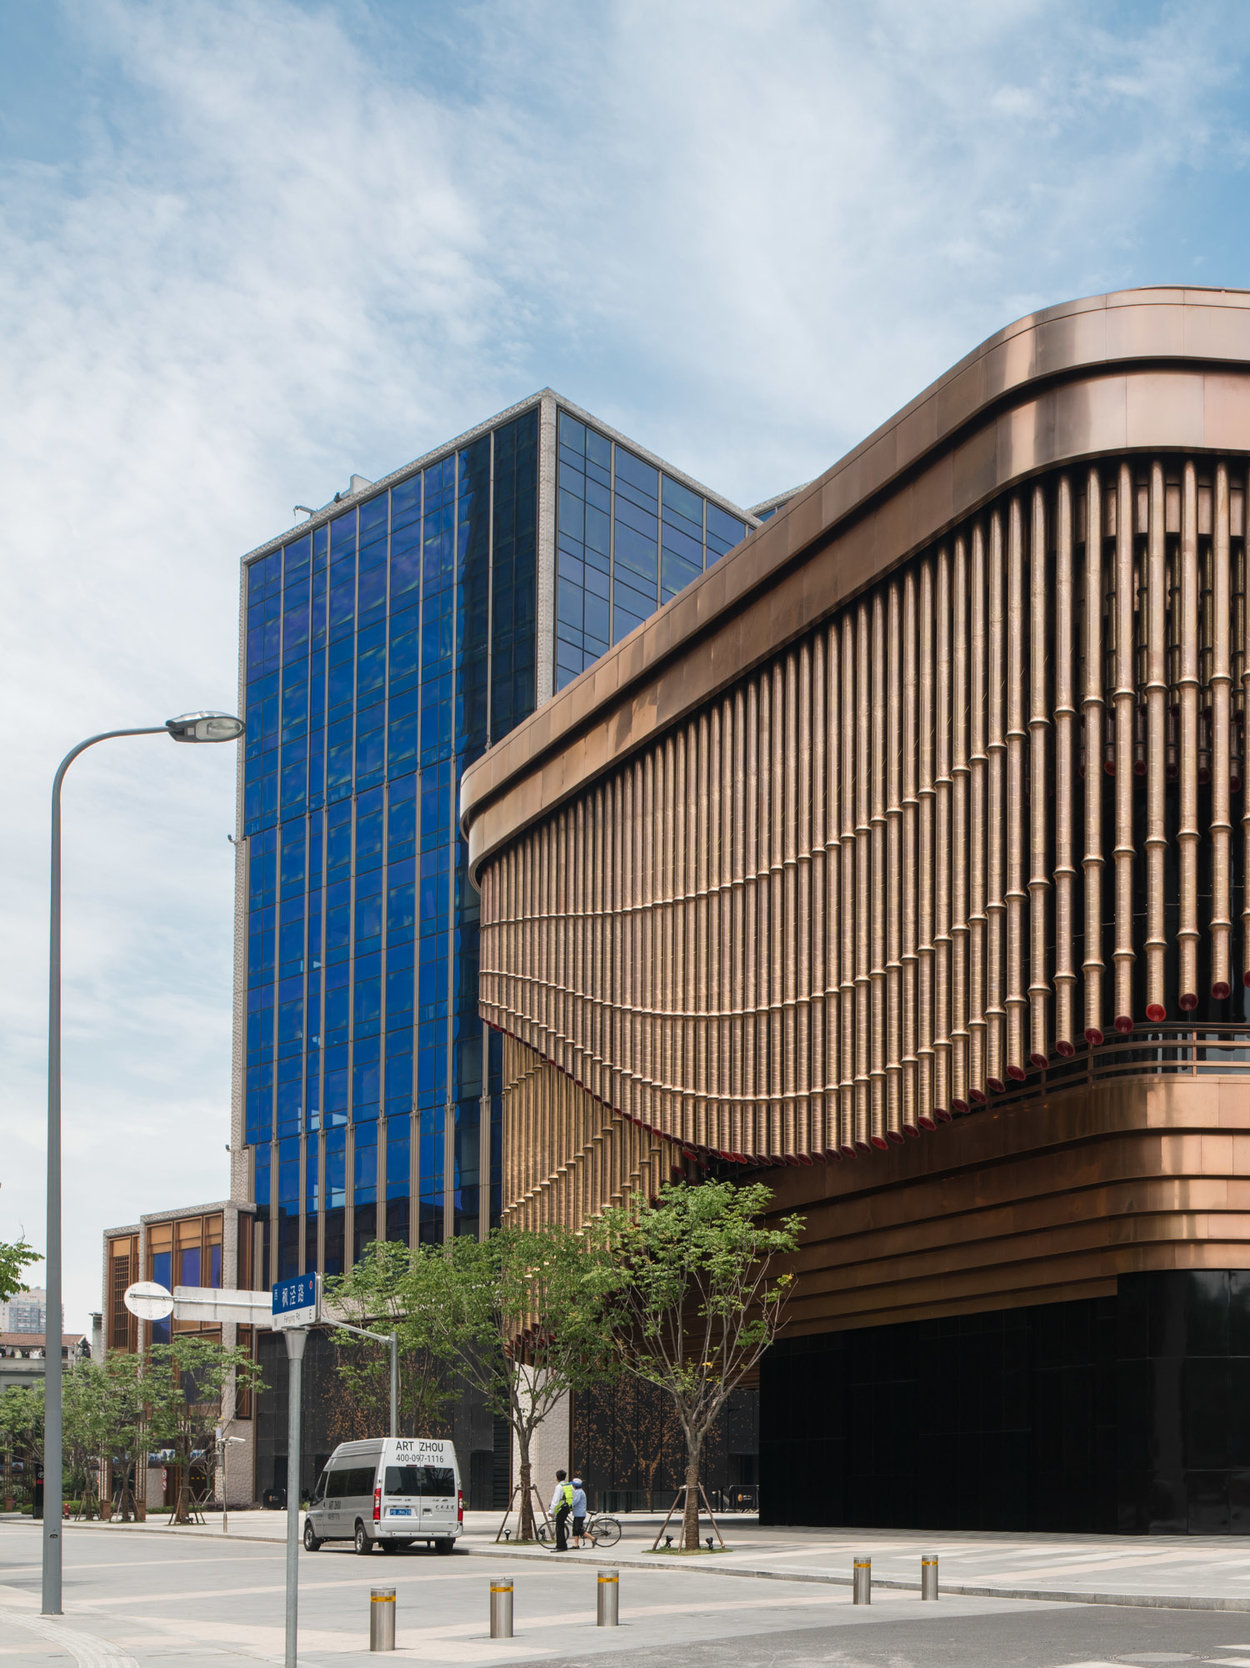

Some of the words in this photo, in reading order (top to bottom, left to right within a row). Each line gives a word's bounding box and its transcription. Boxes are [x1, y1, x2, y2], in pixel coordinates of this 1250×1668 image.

[282, 1283, 305, 1308] 枫泾路
[396, 1441, 414, 1451] ART
[419, 1442, 444, 1452] ZHOU
[396, 1454, 444, 1463] 400-097-1116
